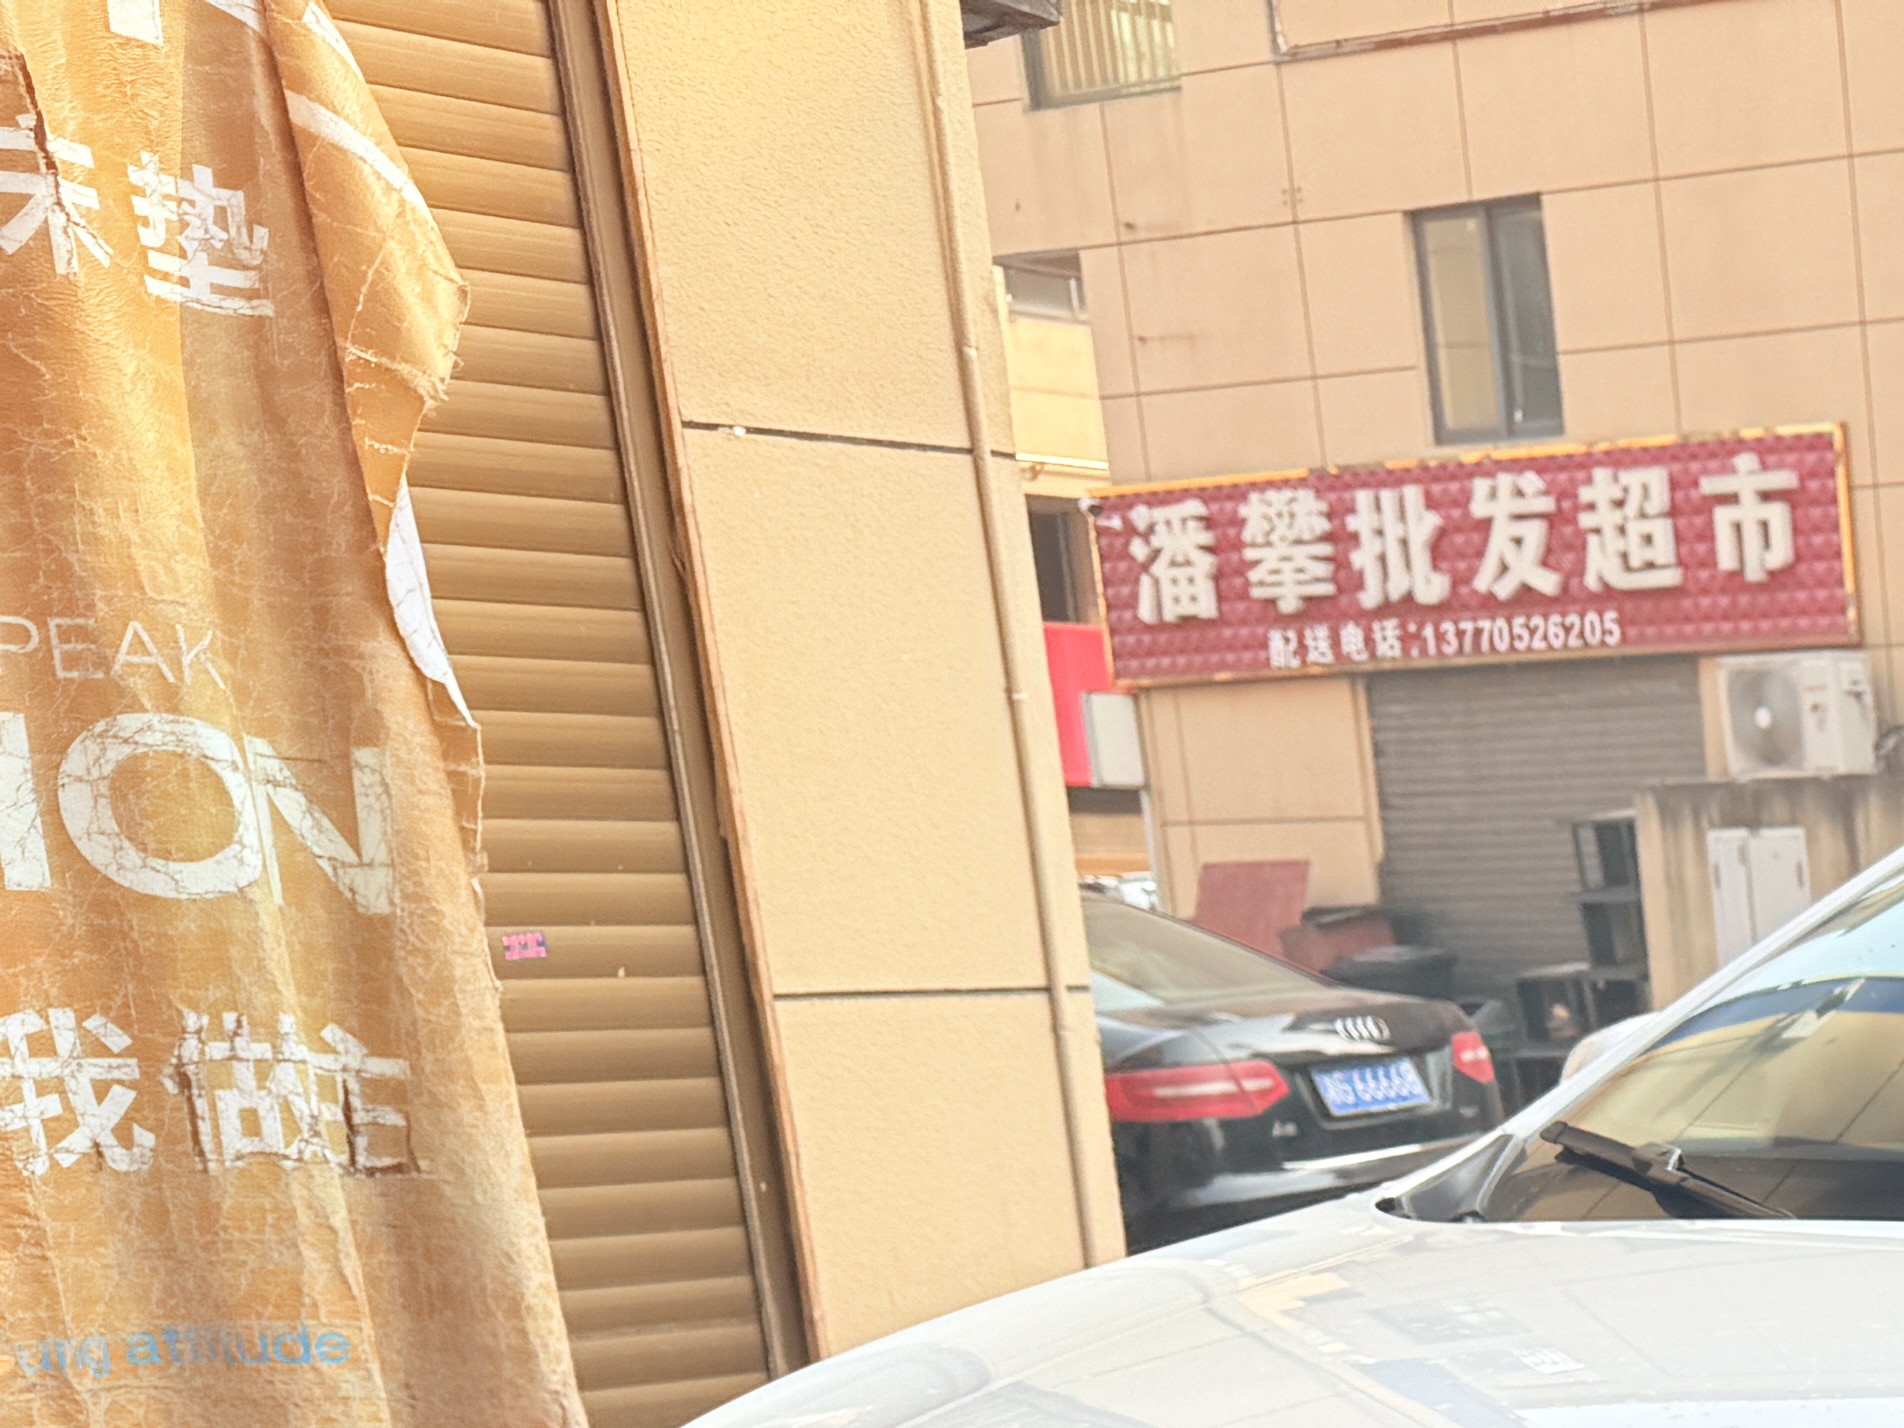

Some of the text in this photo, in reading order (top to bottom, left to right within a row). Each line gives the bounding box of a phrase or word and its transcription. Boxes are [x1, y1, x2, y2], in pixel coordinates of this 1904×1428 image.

[1129, 451, 1799, 626] 潘攀批发超市
